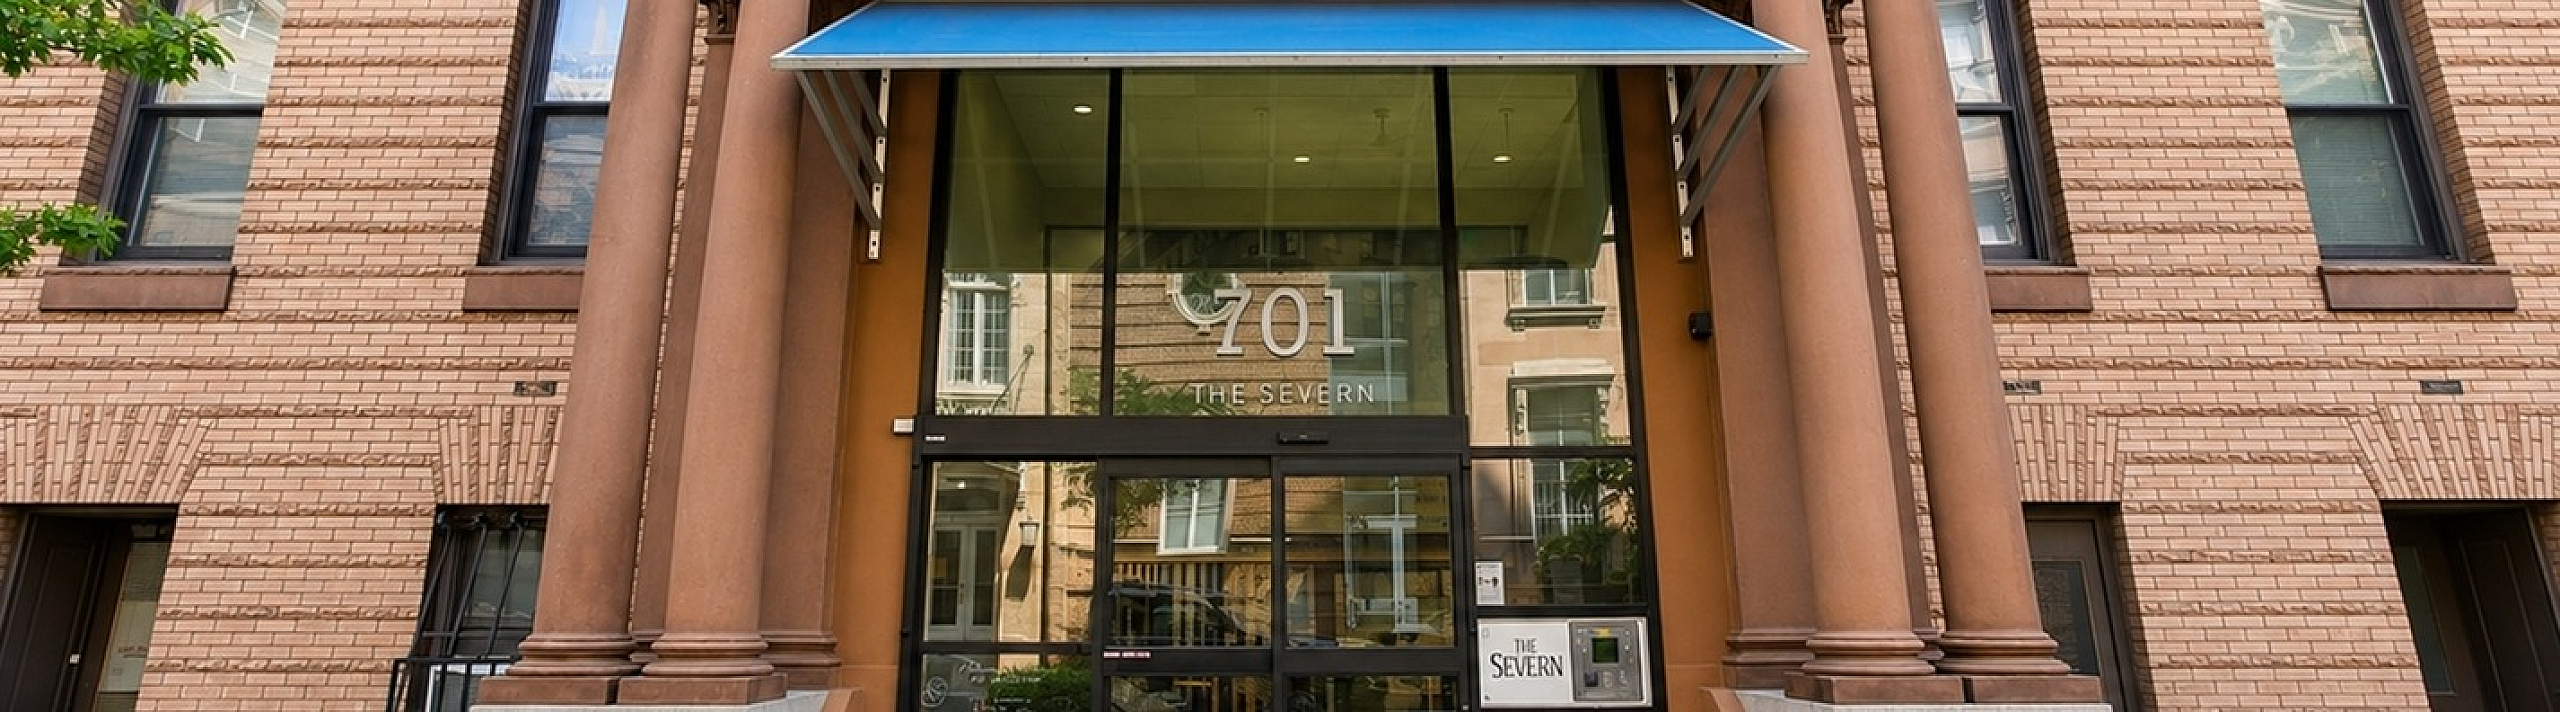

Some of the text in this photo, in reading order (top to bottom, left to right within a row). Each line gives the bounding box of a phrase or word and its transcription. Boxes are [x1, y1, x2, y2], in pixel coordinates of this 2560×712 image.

[1213, 287, 1355, 357] 701
[1189, 383, 1374, 404] THE SEVERN
[1514, 638, 1537, 653] THE
